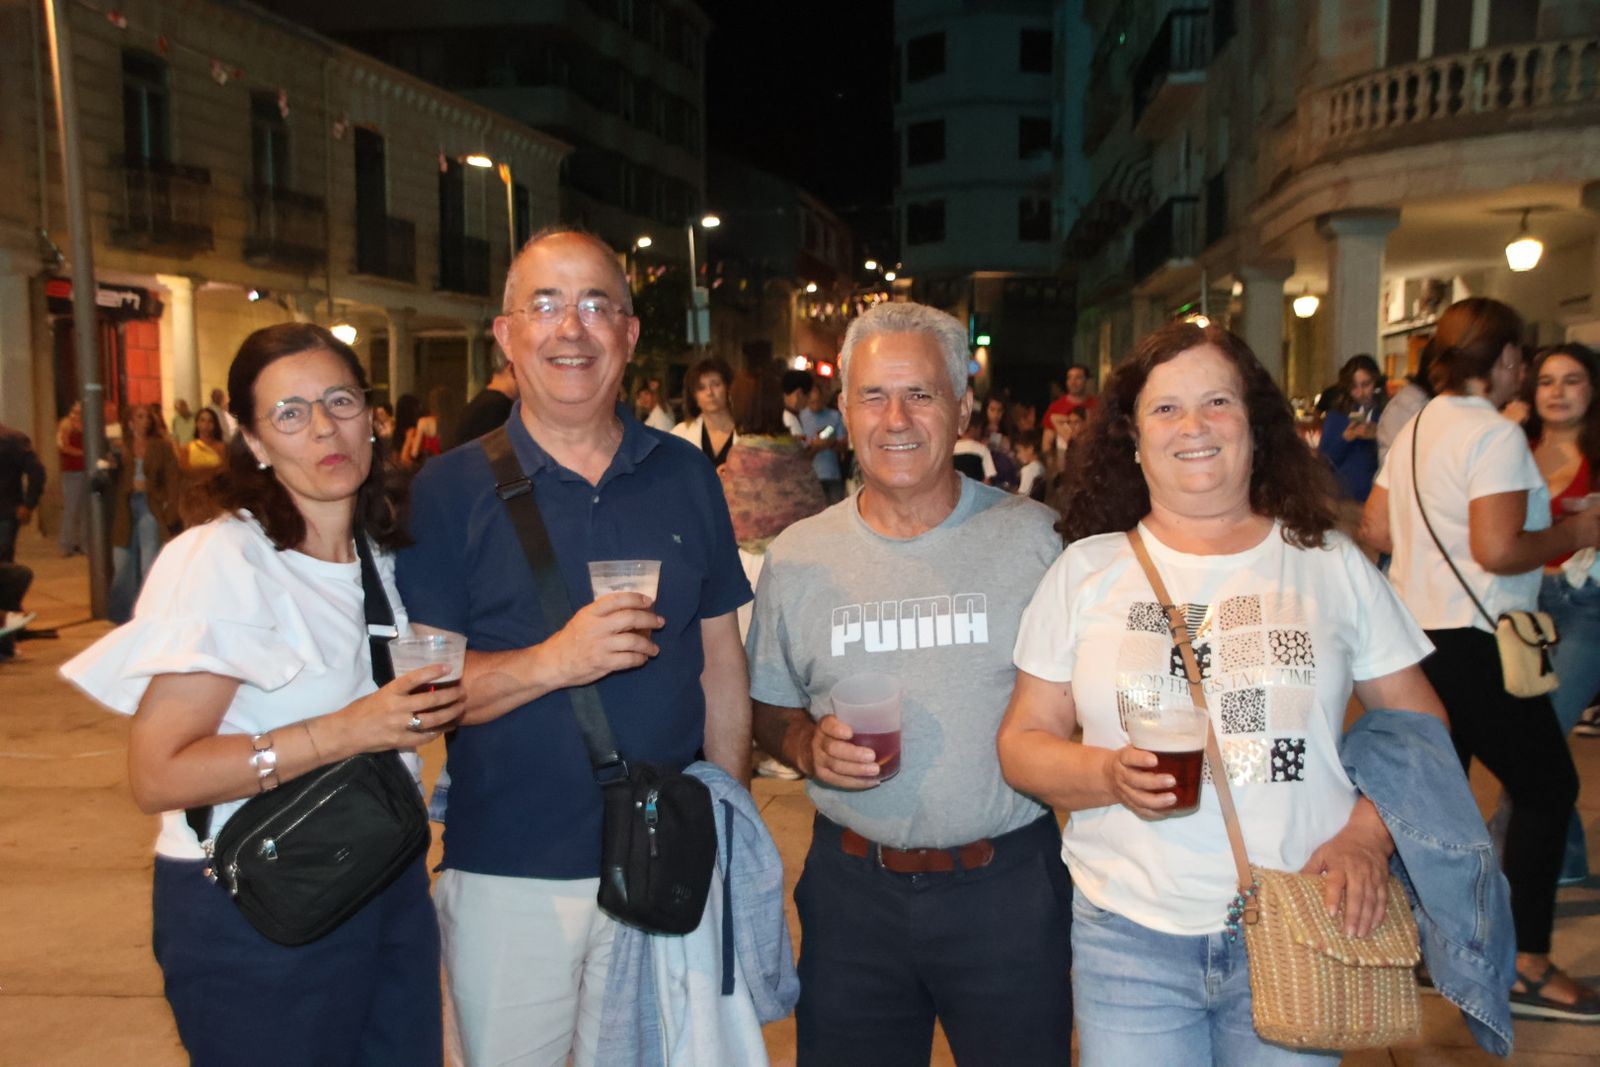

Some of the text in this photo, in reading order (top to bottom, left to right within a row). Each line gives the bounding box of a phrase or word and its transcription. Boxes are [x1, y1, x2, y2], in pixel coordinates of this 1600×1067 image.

[831, 593, 989, 656] PUMA
[1166, 676, 1225, 696] THGS
[1278, 668, 1316, 687] TIME
